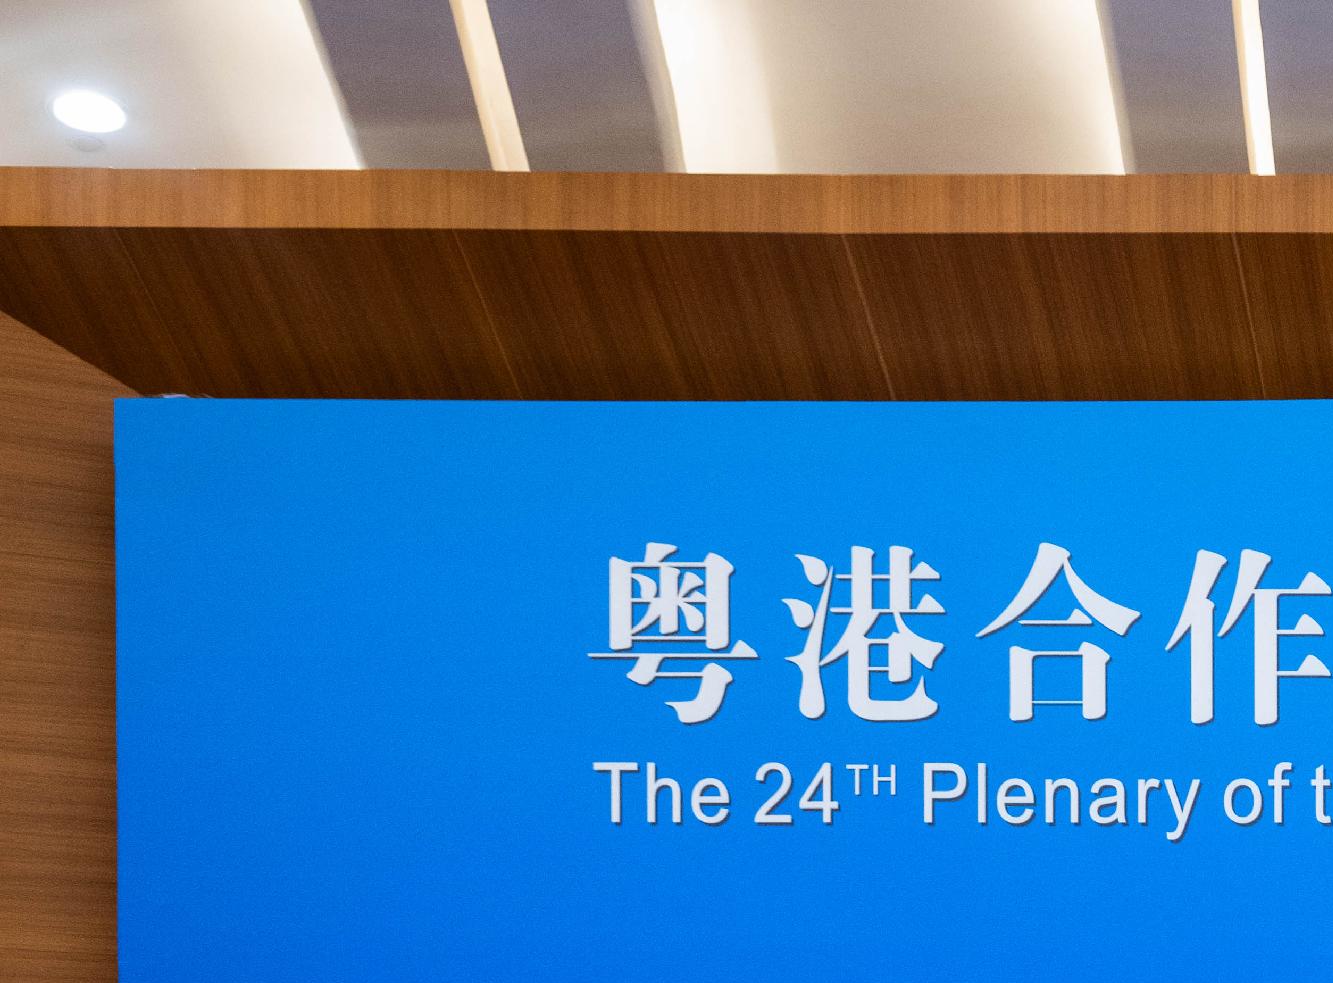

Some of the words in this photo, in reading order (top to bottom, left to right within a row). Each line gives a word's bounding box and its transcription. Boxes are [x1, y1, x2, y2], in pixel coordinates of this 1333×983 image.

[593, 762, 730, 825] The
[754, 762, 896, 825] 24TH
[923, 762, 1200, 841] Plenary
[1223, 761, 1292, 825] of
